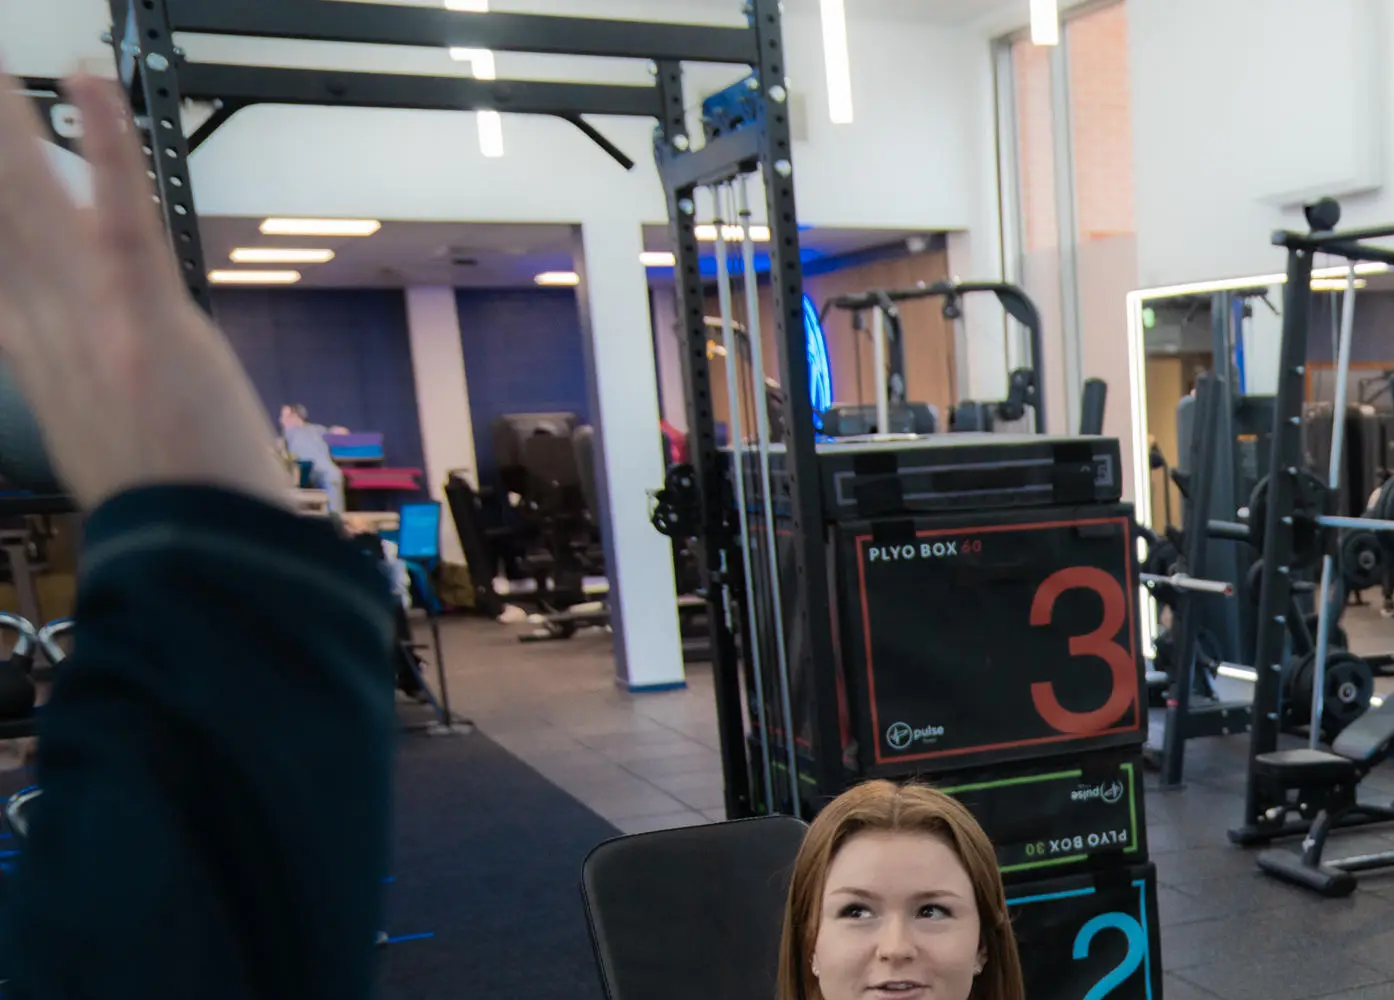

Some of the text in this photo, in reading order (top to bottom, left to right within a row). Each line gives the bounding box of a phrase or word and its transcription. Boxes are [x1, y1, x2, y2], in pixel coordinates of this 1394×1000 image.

[868, 544, 916, 562] PLYO
[920, 541, 958, 558] BOX
[1029, 566, 1137, 737] 3
[914, 725, 945, 740] pulse
[1070, 786, 1101, 801] pulse
[1025, 828, 1128, 856] PLYO BOX 30
